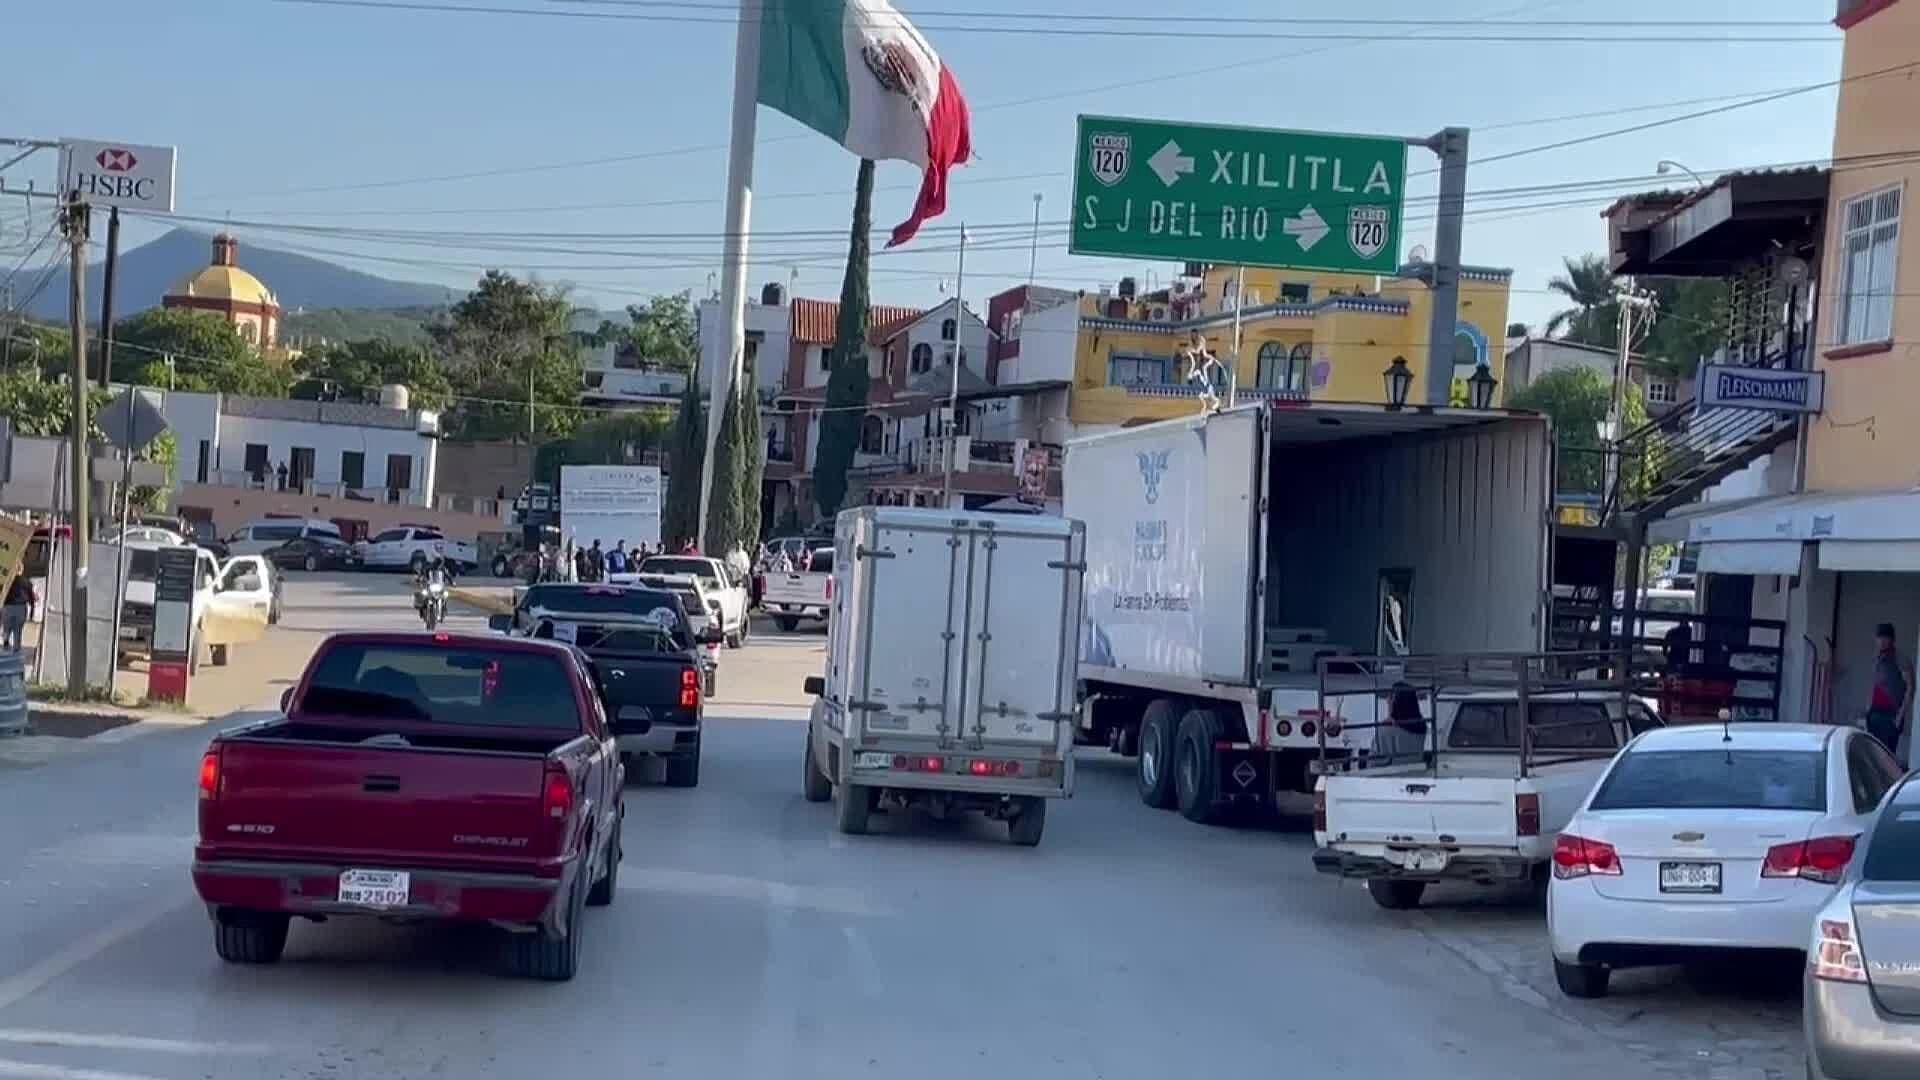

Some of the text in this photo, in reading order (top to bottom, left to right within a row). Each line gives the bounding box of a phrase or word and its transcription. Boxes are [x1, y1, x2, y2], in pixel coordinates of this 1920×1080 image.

[1096, 150, 1124, 174] 120
[1209, 149, 1392, 195] XILITLA
[78, 172, 155, 201] HSBC
[1083, 195, 1269, 242] S J DEL RIO
[1354, 223, 1382, 246] 120
[1719, 375, 1808, 403] FLEISCHMANN
